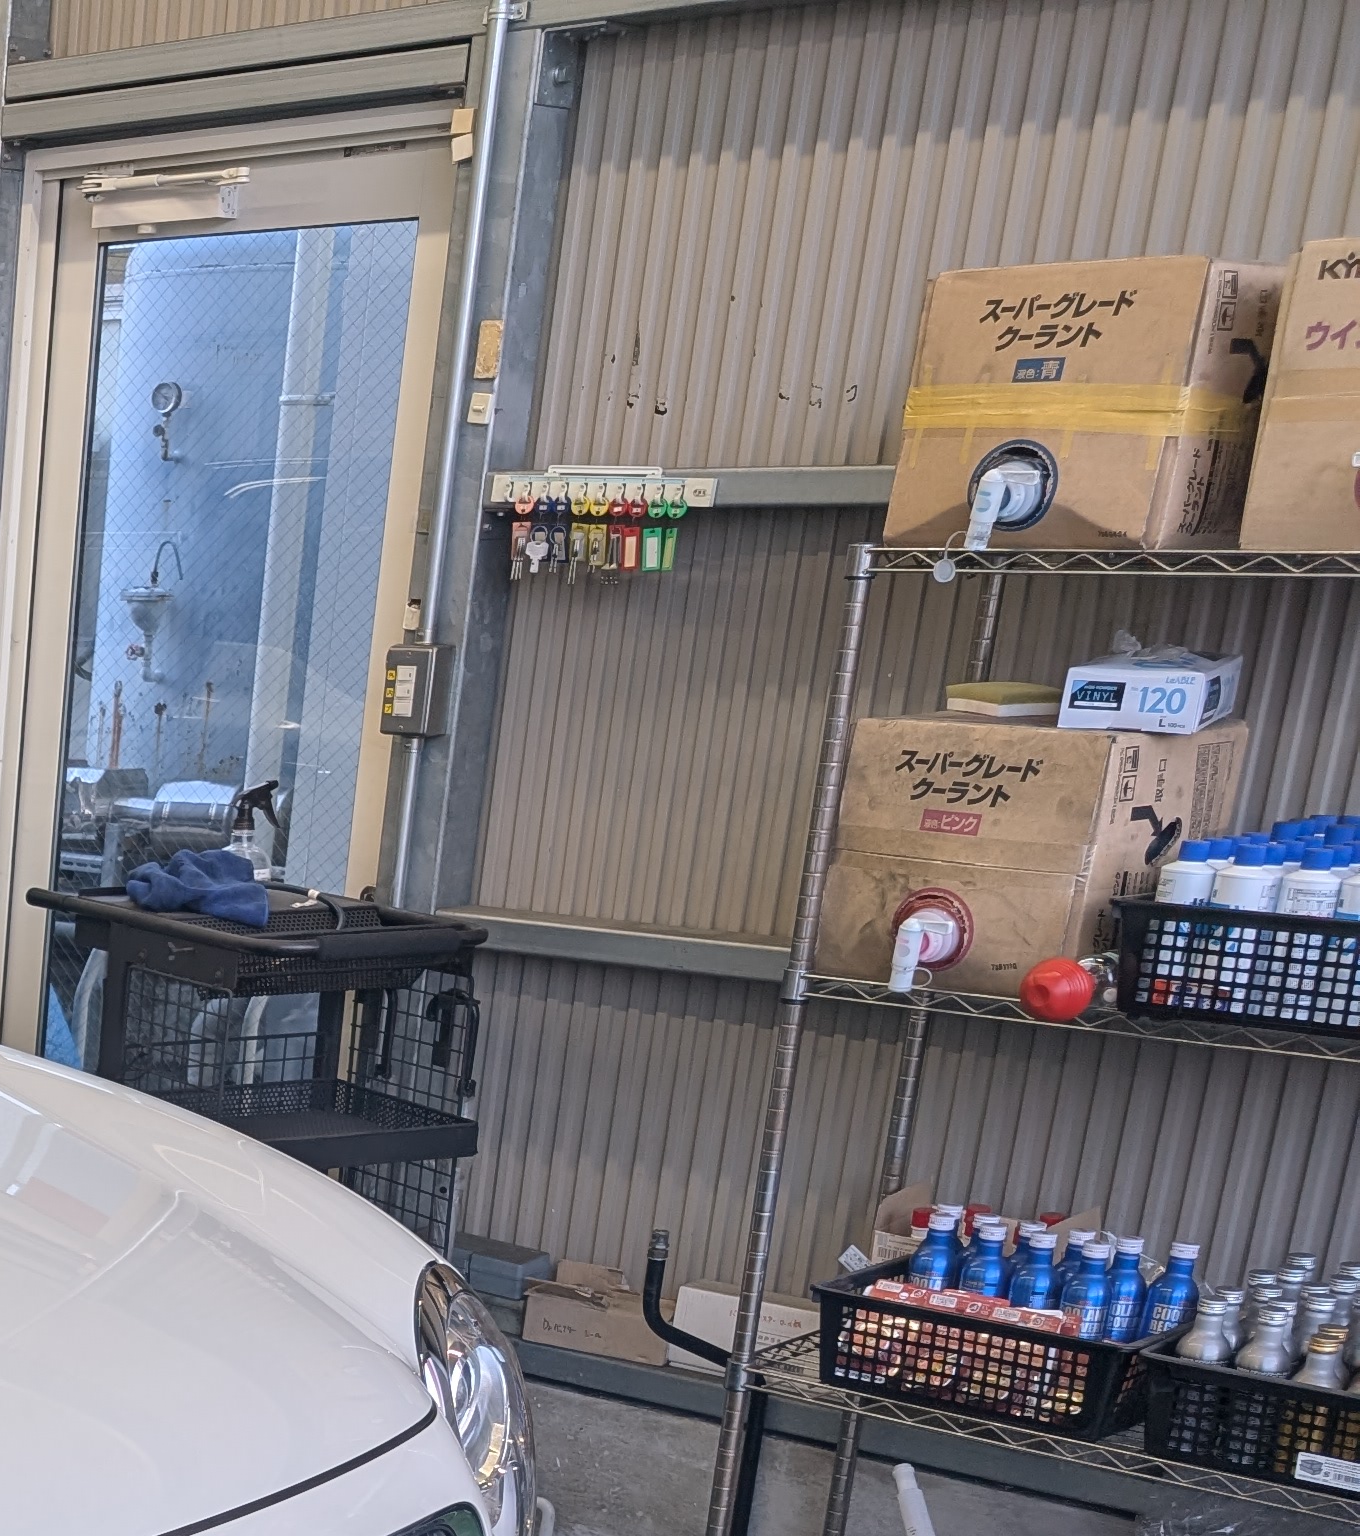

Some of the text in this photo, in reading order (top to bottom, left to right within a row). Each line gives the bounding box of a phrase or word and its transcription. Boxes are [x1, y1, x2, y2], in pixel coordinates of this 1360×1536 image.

[979, 289, 1138, 323] スーパーグレード
[994, 322, 1103, 352] クーラント
[1076, 690, 1117, 702] VINYL
[1138, 686, 1186, 714] 120
[1159, 718, 1166, 727] L
[895, 750, 1044, 782] スーパーグレード
[910, 778, 1011, 807] クーラント
